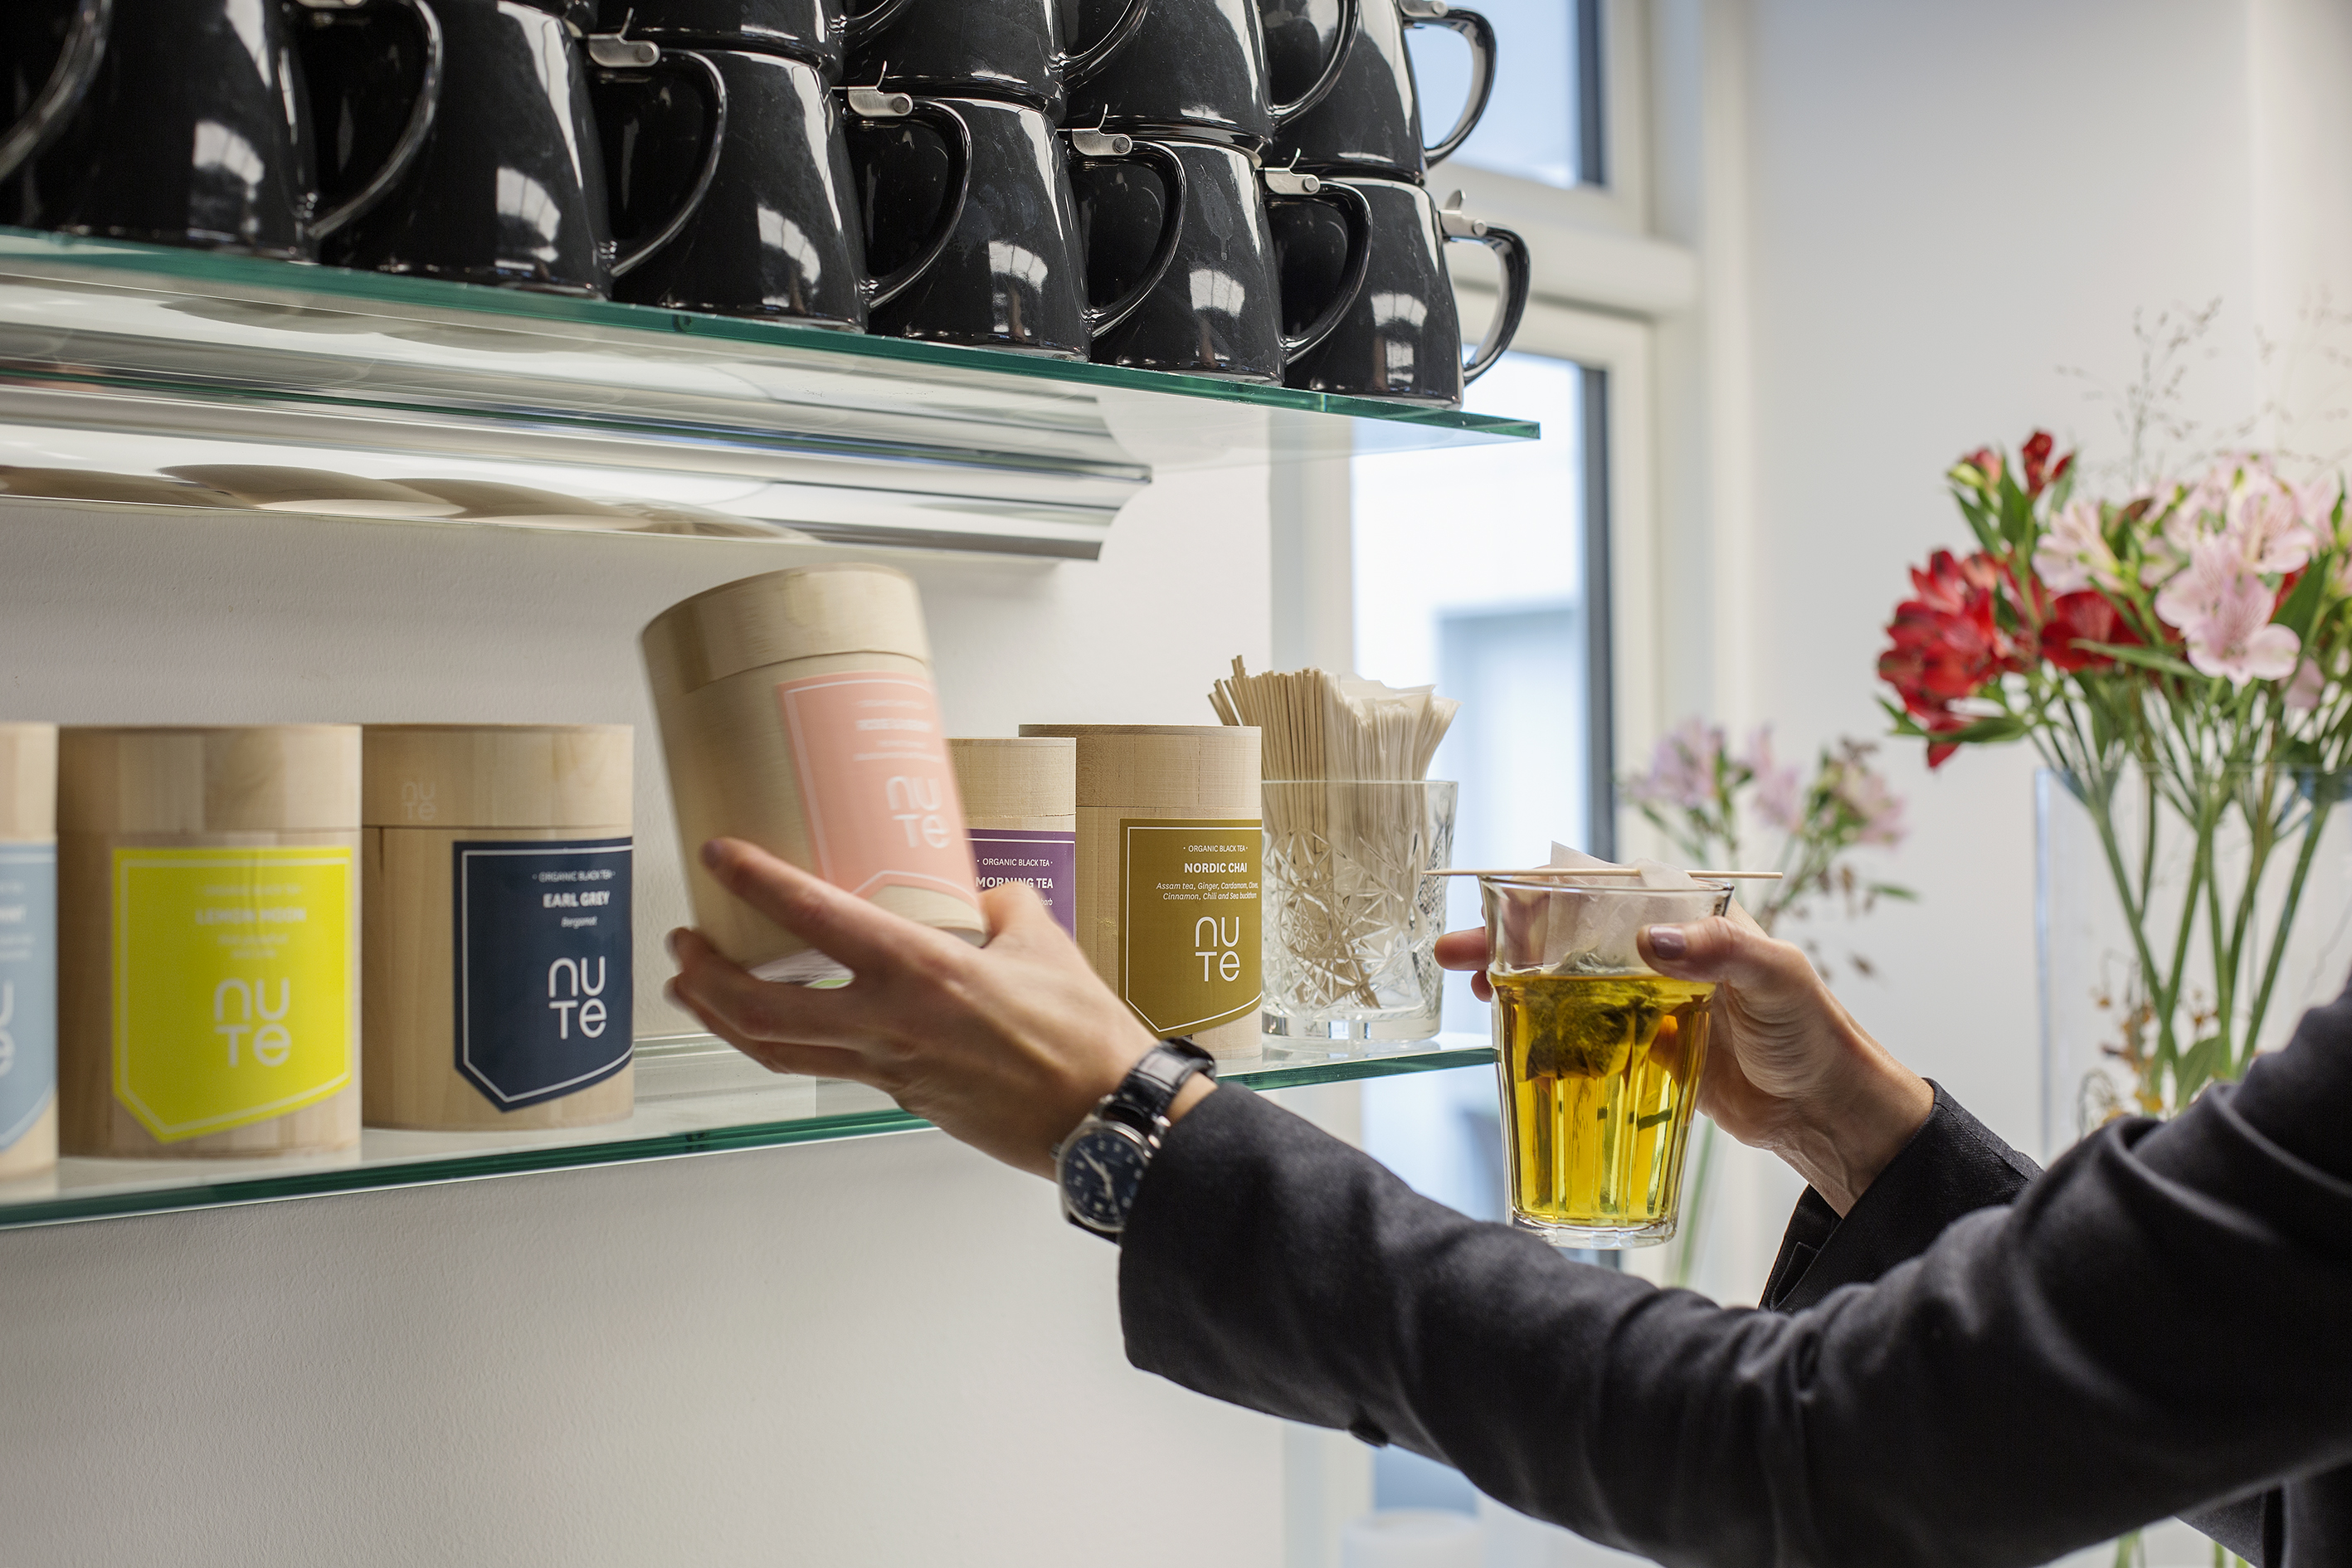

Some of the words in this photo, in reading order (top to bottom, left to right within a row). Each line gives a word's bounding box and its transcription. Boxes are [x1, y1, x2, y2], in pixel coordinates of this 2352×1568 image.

[1188, 845, 1219, 853] ORGANIC
[1219, 845, 1237, 853] BLACK
[982, 858, 1017, 866] ORGANIC
[1018, 859, 1039, 867] BLACK
[1040, 859, 1050, 867] TEA
[1184, 862, 1227, 874] NORDIC
[1228, 862, 1248, 873] CHAI
[1036, 878, 1054, 889] TEA
[1156, 882, 1181, 890] Assam
[1182, 882, 1196, 891] tea,
[1197, 882, 1220, 892] Ginger,
[543, 892, 579, 908] EARL
[579, 890, 611, 908] GREY
[1162, 892, 1202, 901] Cinnamon,
[1202, 892, 1218, 900] Chili
[1218, 892, 1230, 900] and
